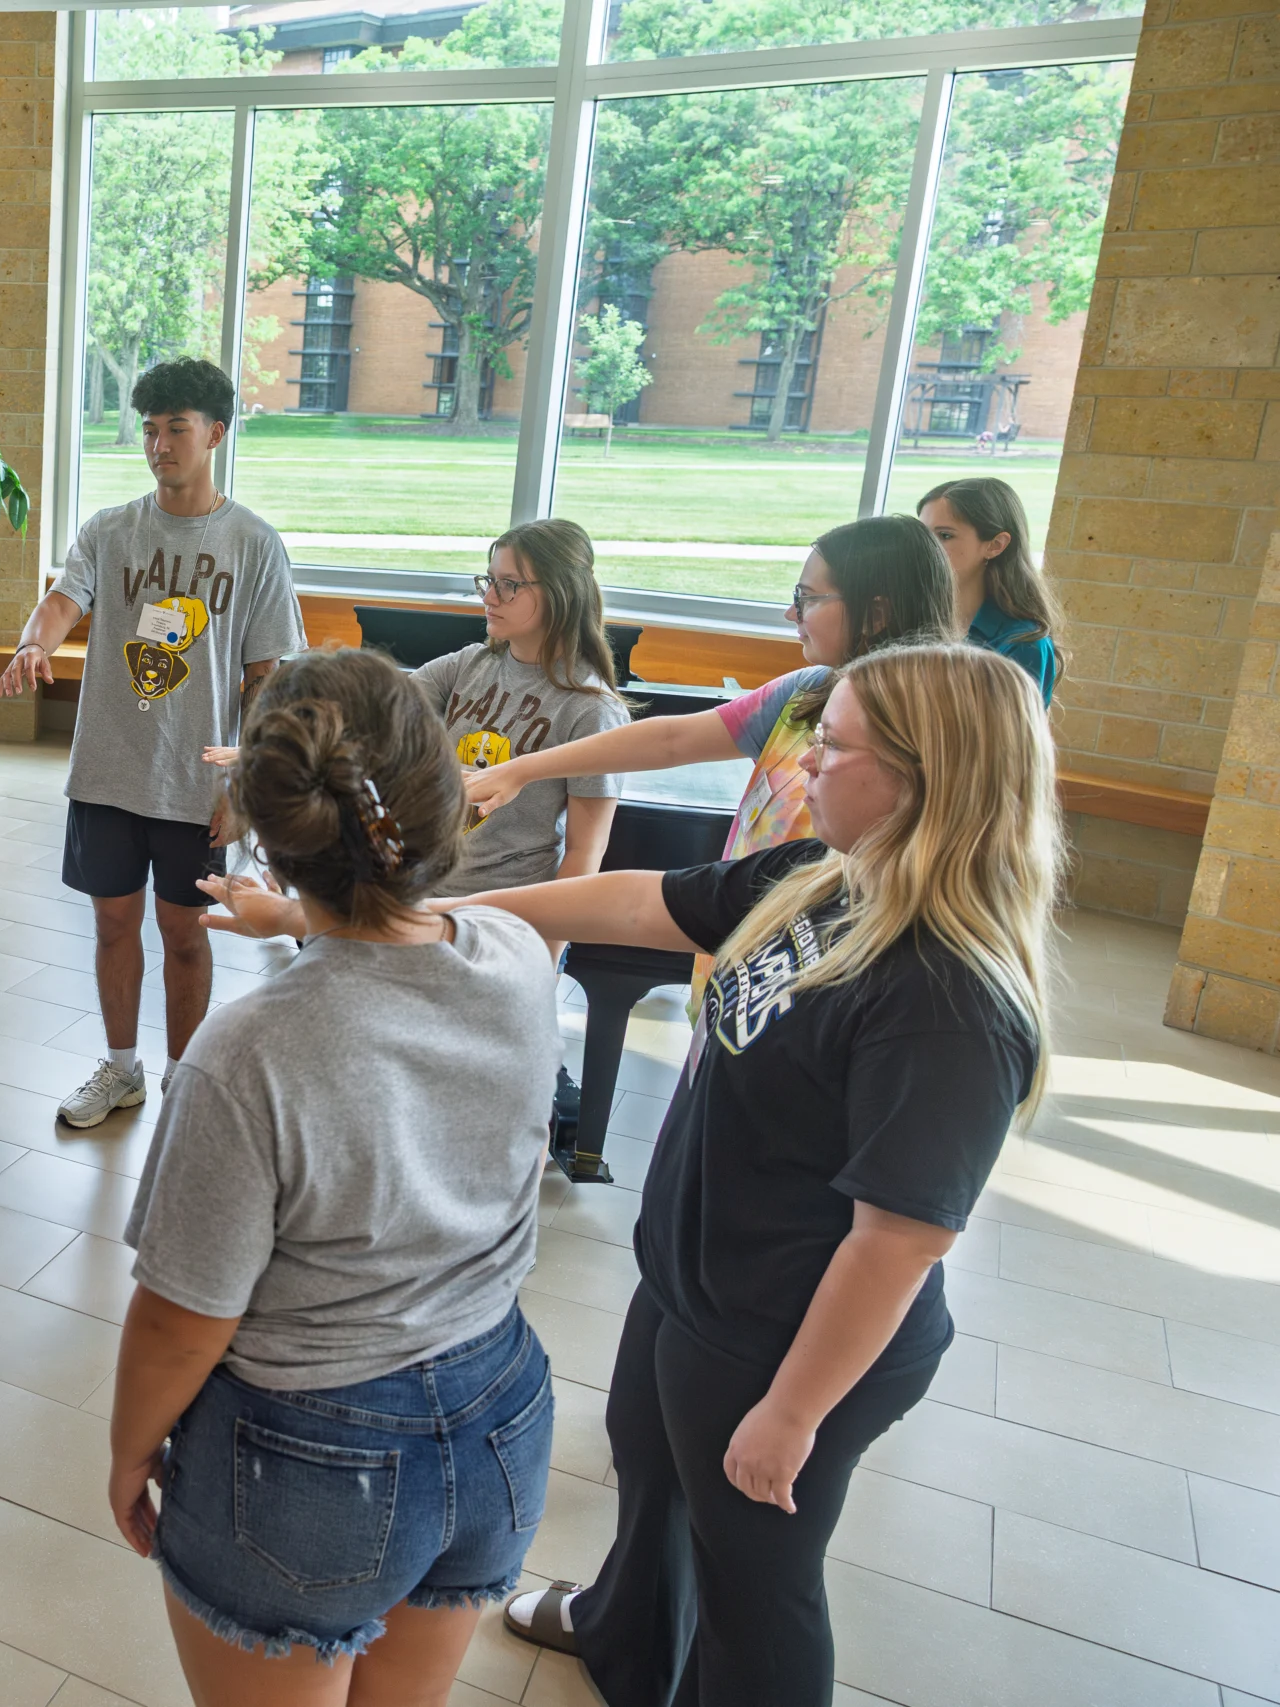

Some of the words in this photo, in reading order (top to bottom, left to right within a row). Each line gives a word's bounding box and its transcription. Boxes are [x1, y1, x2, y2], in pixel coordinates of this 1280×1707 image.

[123, 547, 234, 615] VALPO
[446, 682, 552, 756] VALPO
[734, 961, 749, 1017] UEJAYS
